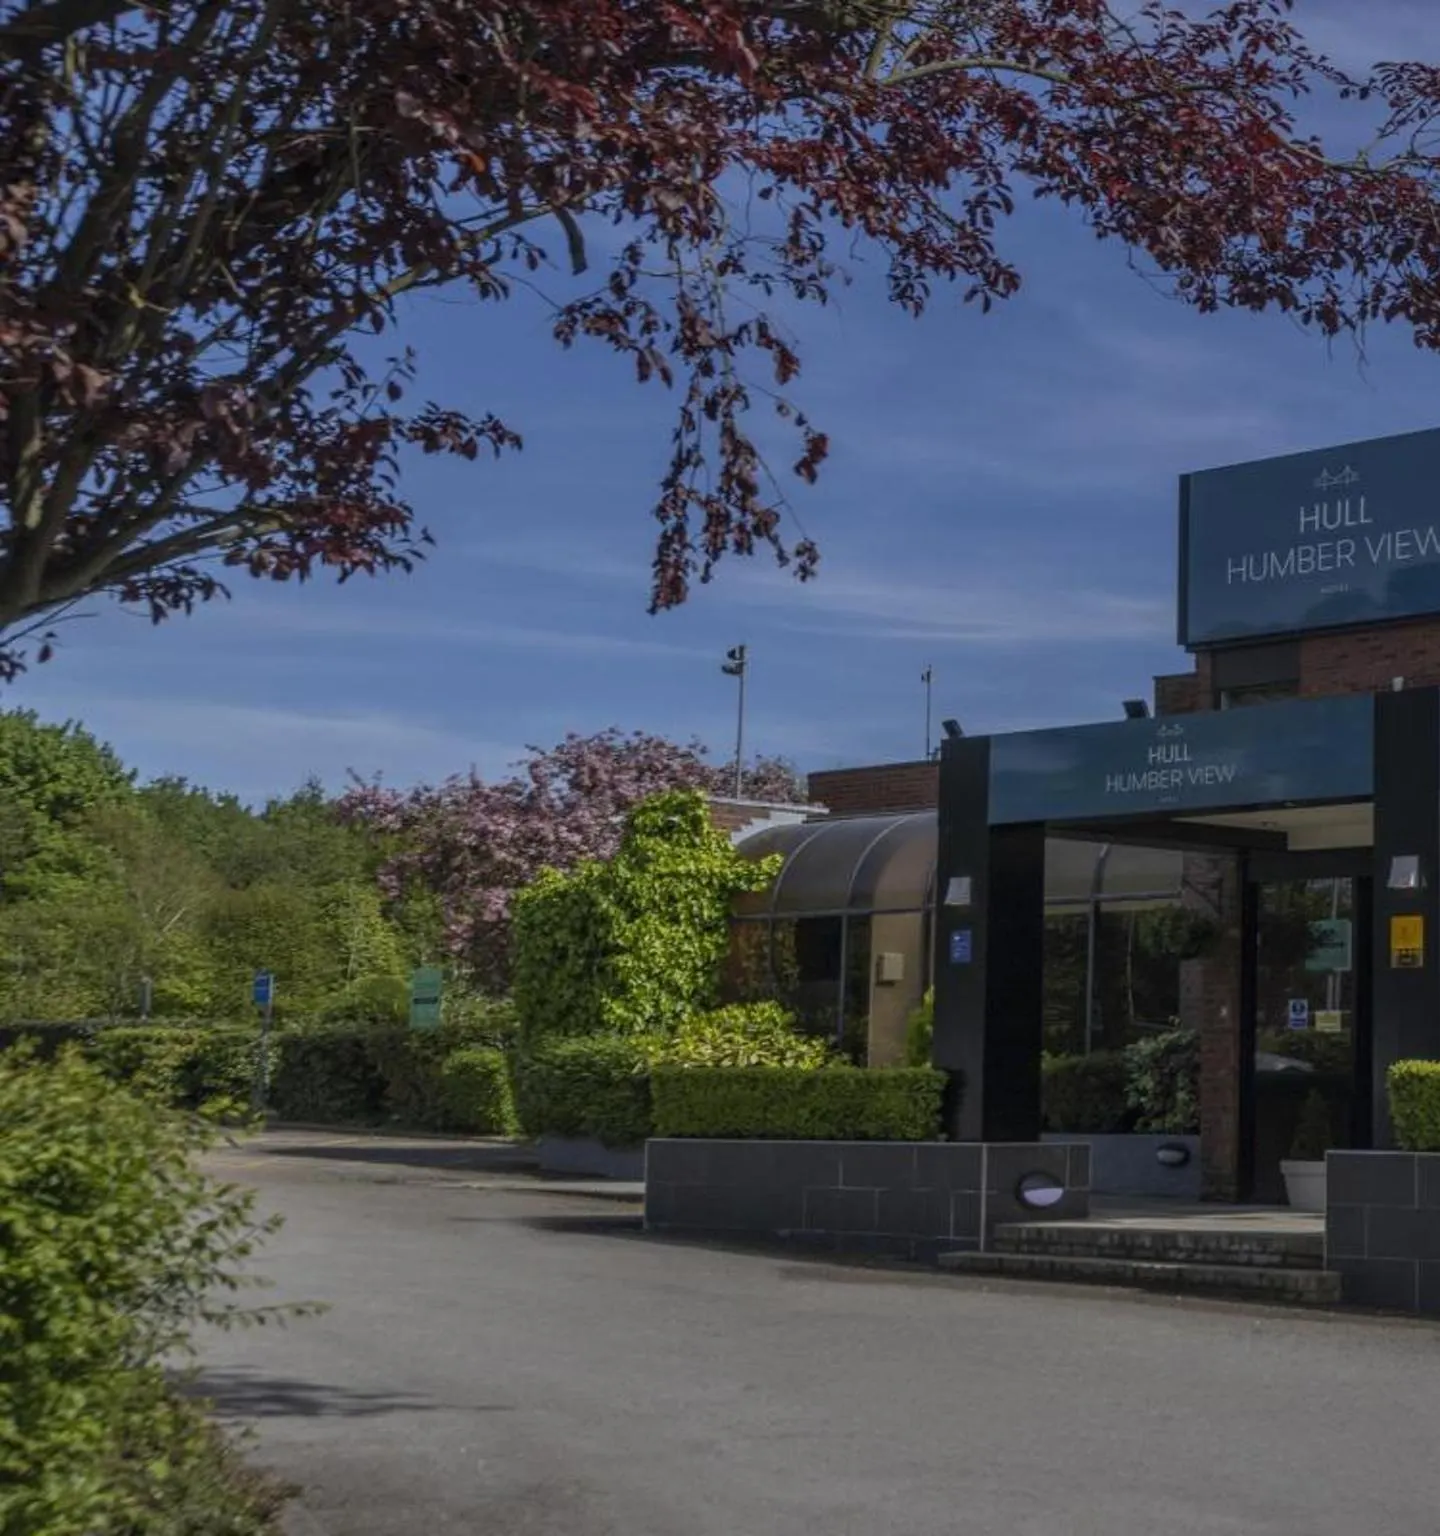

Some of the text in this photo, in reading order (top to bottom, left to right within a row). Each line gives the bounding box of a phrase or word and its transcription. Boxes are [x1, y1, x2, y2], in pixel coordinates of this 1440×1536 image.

[1299, 495, 1373, 534] HULL
[1227, 538, 1356, 585] HUMBER
[1148, 743, 1193, 765] HULL
[1105, 762, 1237, 793] HUMBER VIEW
